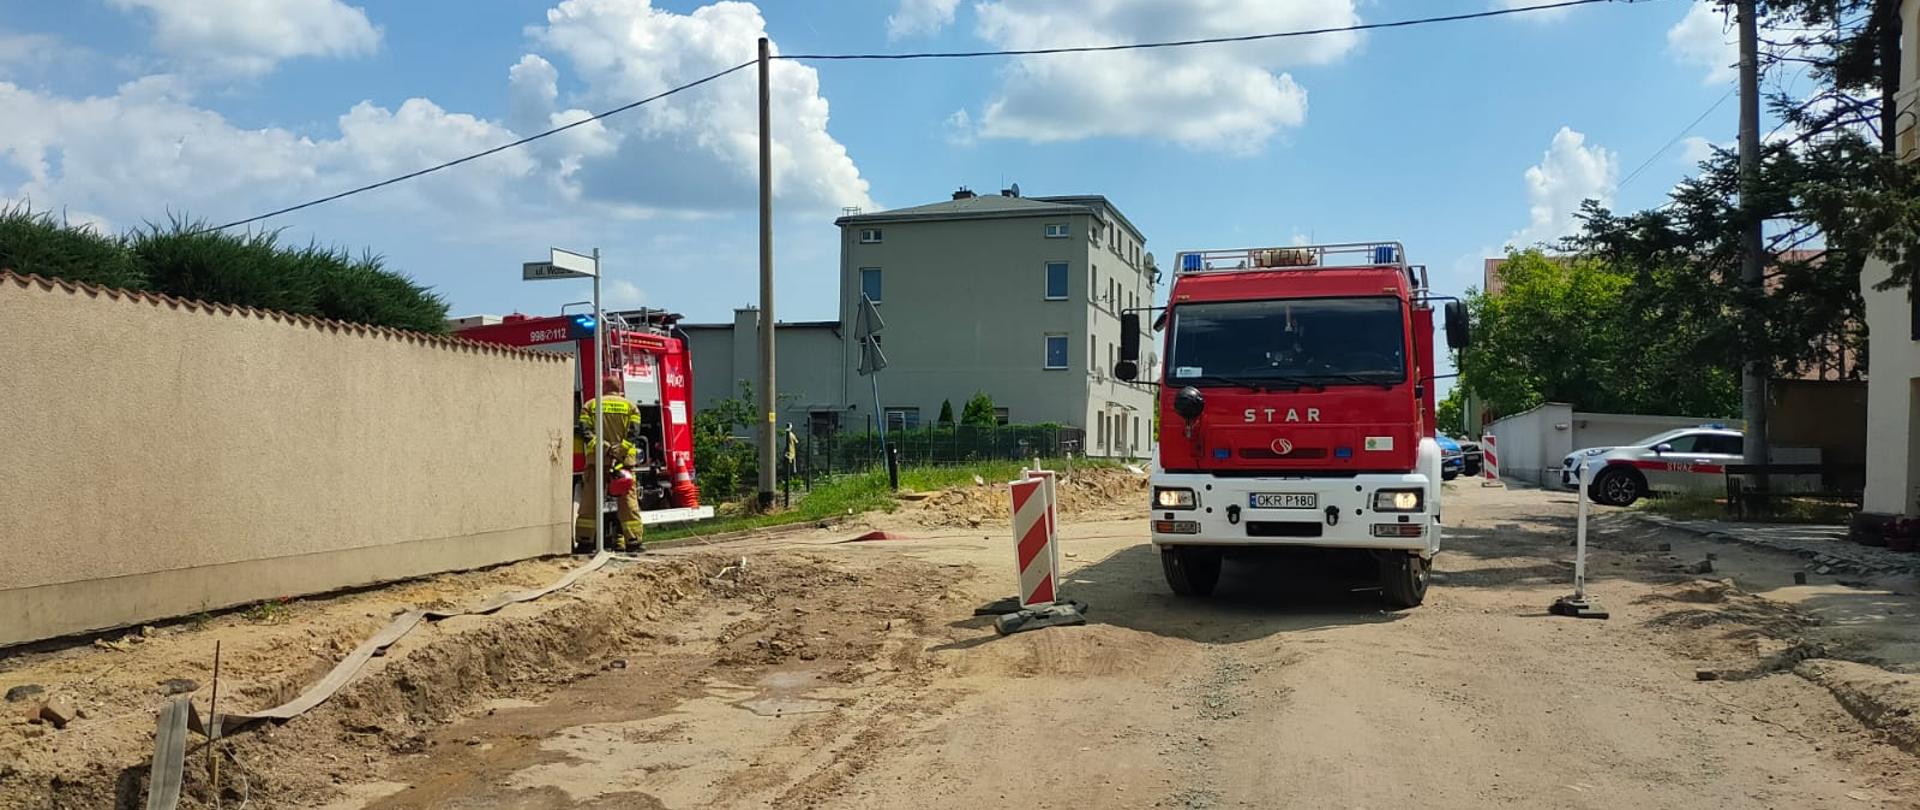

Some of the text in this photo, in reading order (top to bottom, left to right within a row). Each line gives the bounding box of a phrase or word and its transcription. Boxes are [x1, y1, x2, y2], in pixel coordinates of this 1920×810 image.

[529, 327, 567, 342] 998 112
[1243, 407, 1321, 423] STAR
[1257, 495, 1314, 507] OKR P180
